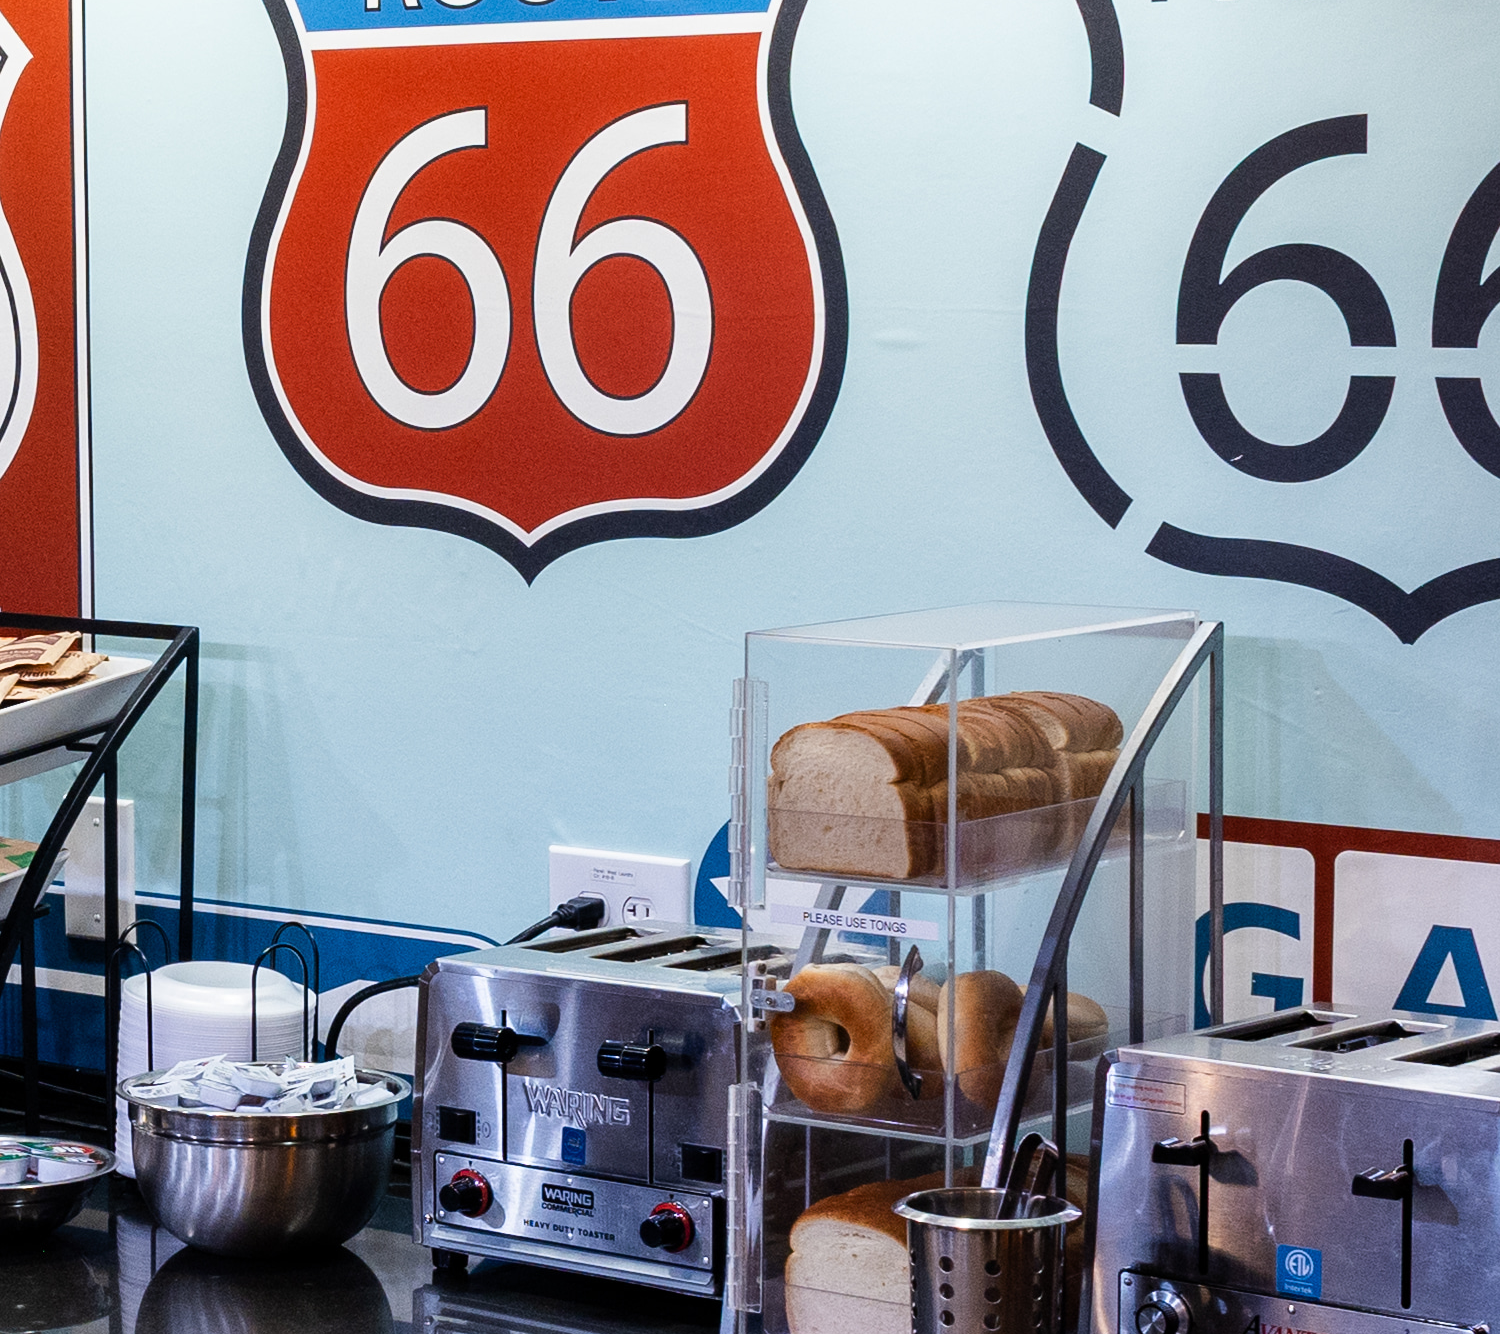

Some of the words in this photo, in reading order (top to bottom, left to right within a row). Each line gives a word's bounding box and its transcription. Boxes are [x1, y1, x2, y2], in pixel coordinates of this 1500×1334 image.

[343, 98, 714, 439] 66
[802, 911, 843, 927] PLEASE
[845, 916, 868, 930] USE
[870, 919, 908, 934] TONGS
[522, 1081, 631, 1129] WARING
[543, 1186, 593, 1207] WARING
[541, 1201, 595, 1218] COMMERCIAL
[523, 1219, 550, 1231] HEAVY
[552, 1223, 575, 1234] DUTY
[577, 1227, 616, 1242] TOASTER
